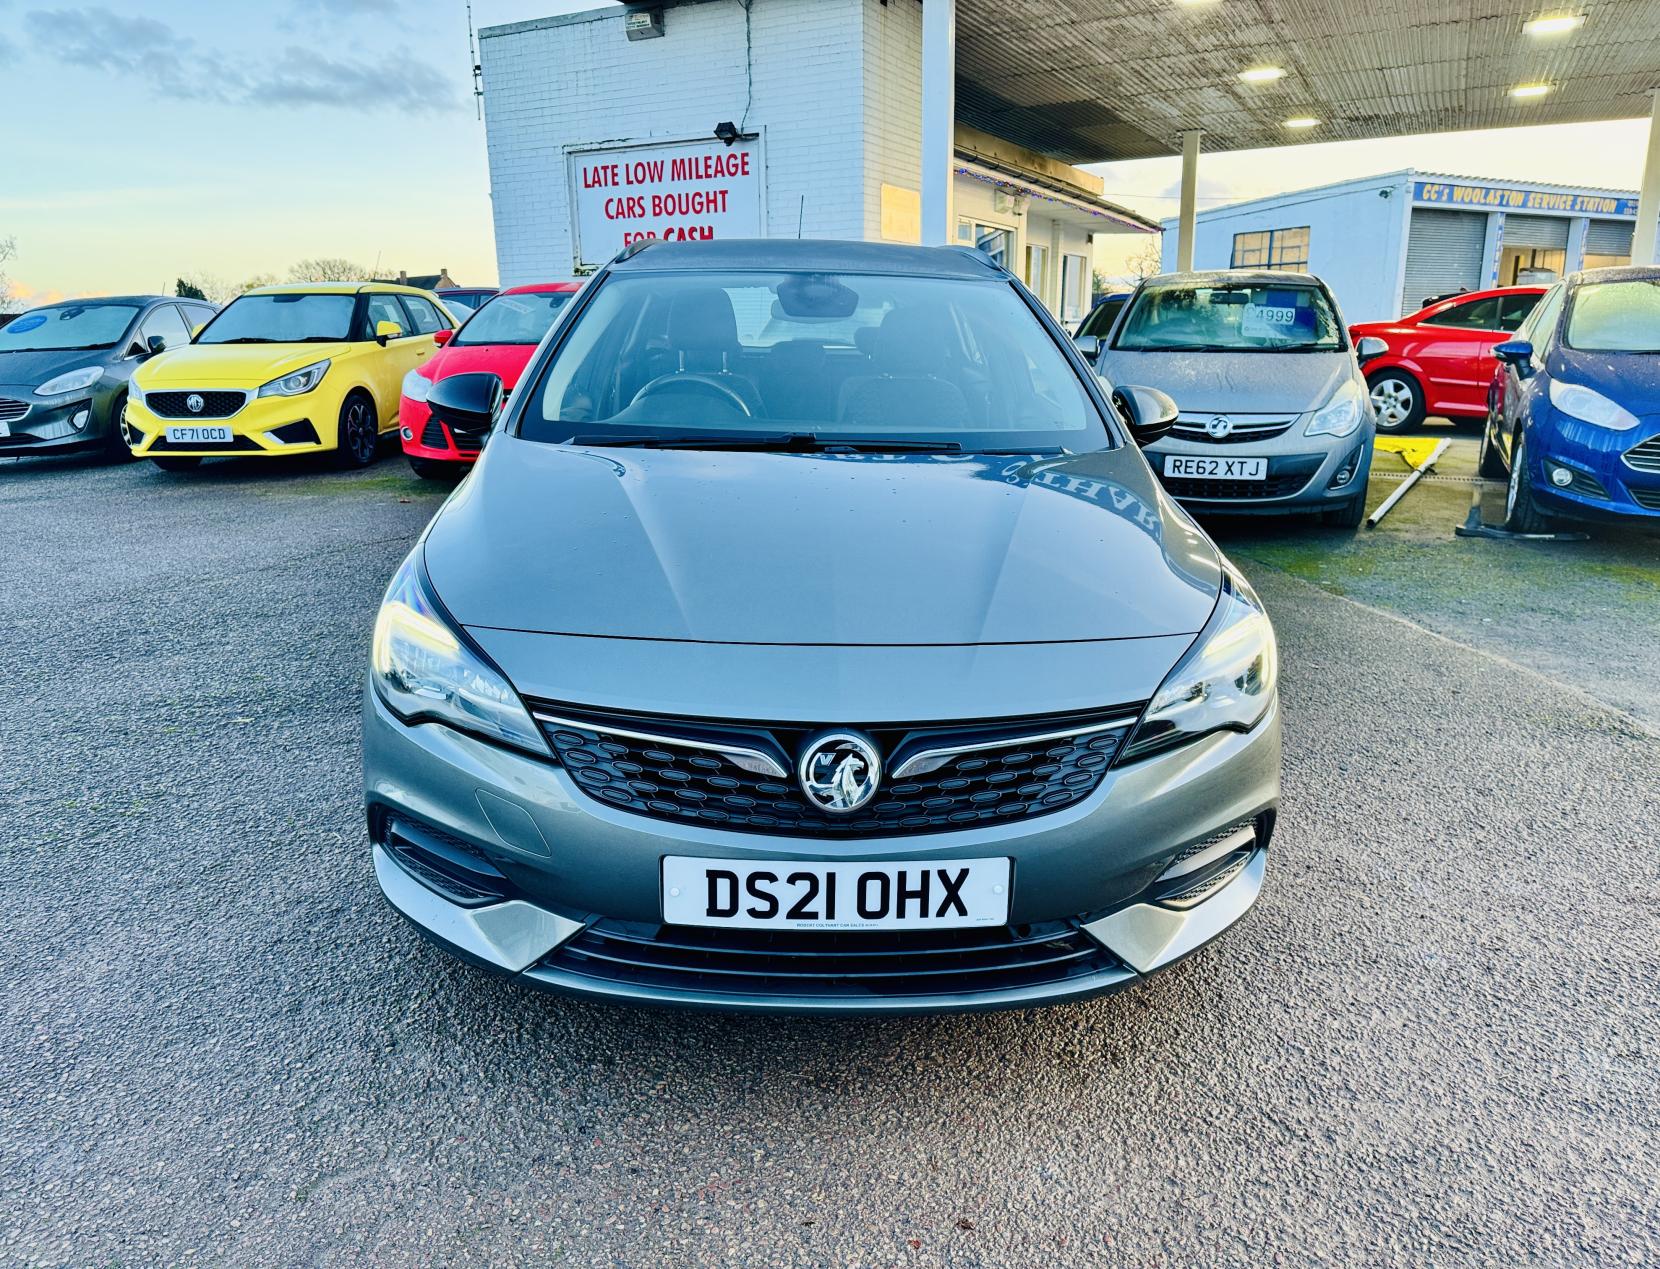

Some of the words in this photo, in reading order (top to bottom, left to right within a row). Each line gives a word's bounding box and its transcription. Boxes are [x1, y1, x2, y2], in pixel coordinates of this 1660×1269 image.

[583, 164, 619, 189] LATE
[625, 159, 665, 185] LOW
[670, 152, 750, 182] MILEAGE
[604, 195, 646, 220] CARS
[652, 189, 729, 217] BOUGHT
[1453, 185, 1525, 206] WOOLASTON
[1527, 191, 1574, 210] SERVICE
[1574, 195, 1618, 214] STATION
[662, 225, 714, 242] CASH
[172, 428, 199, 440] CF71
[202, 428, 226, 440] OCD
[1172, 458, 1219, 476] RE62
[1224, 460, 1260, 477] XTJ
[705, 869, 836, 921] DS21
[856, 867, 970, 920] OHX
